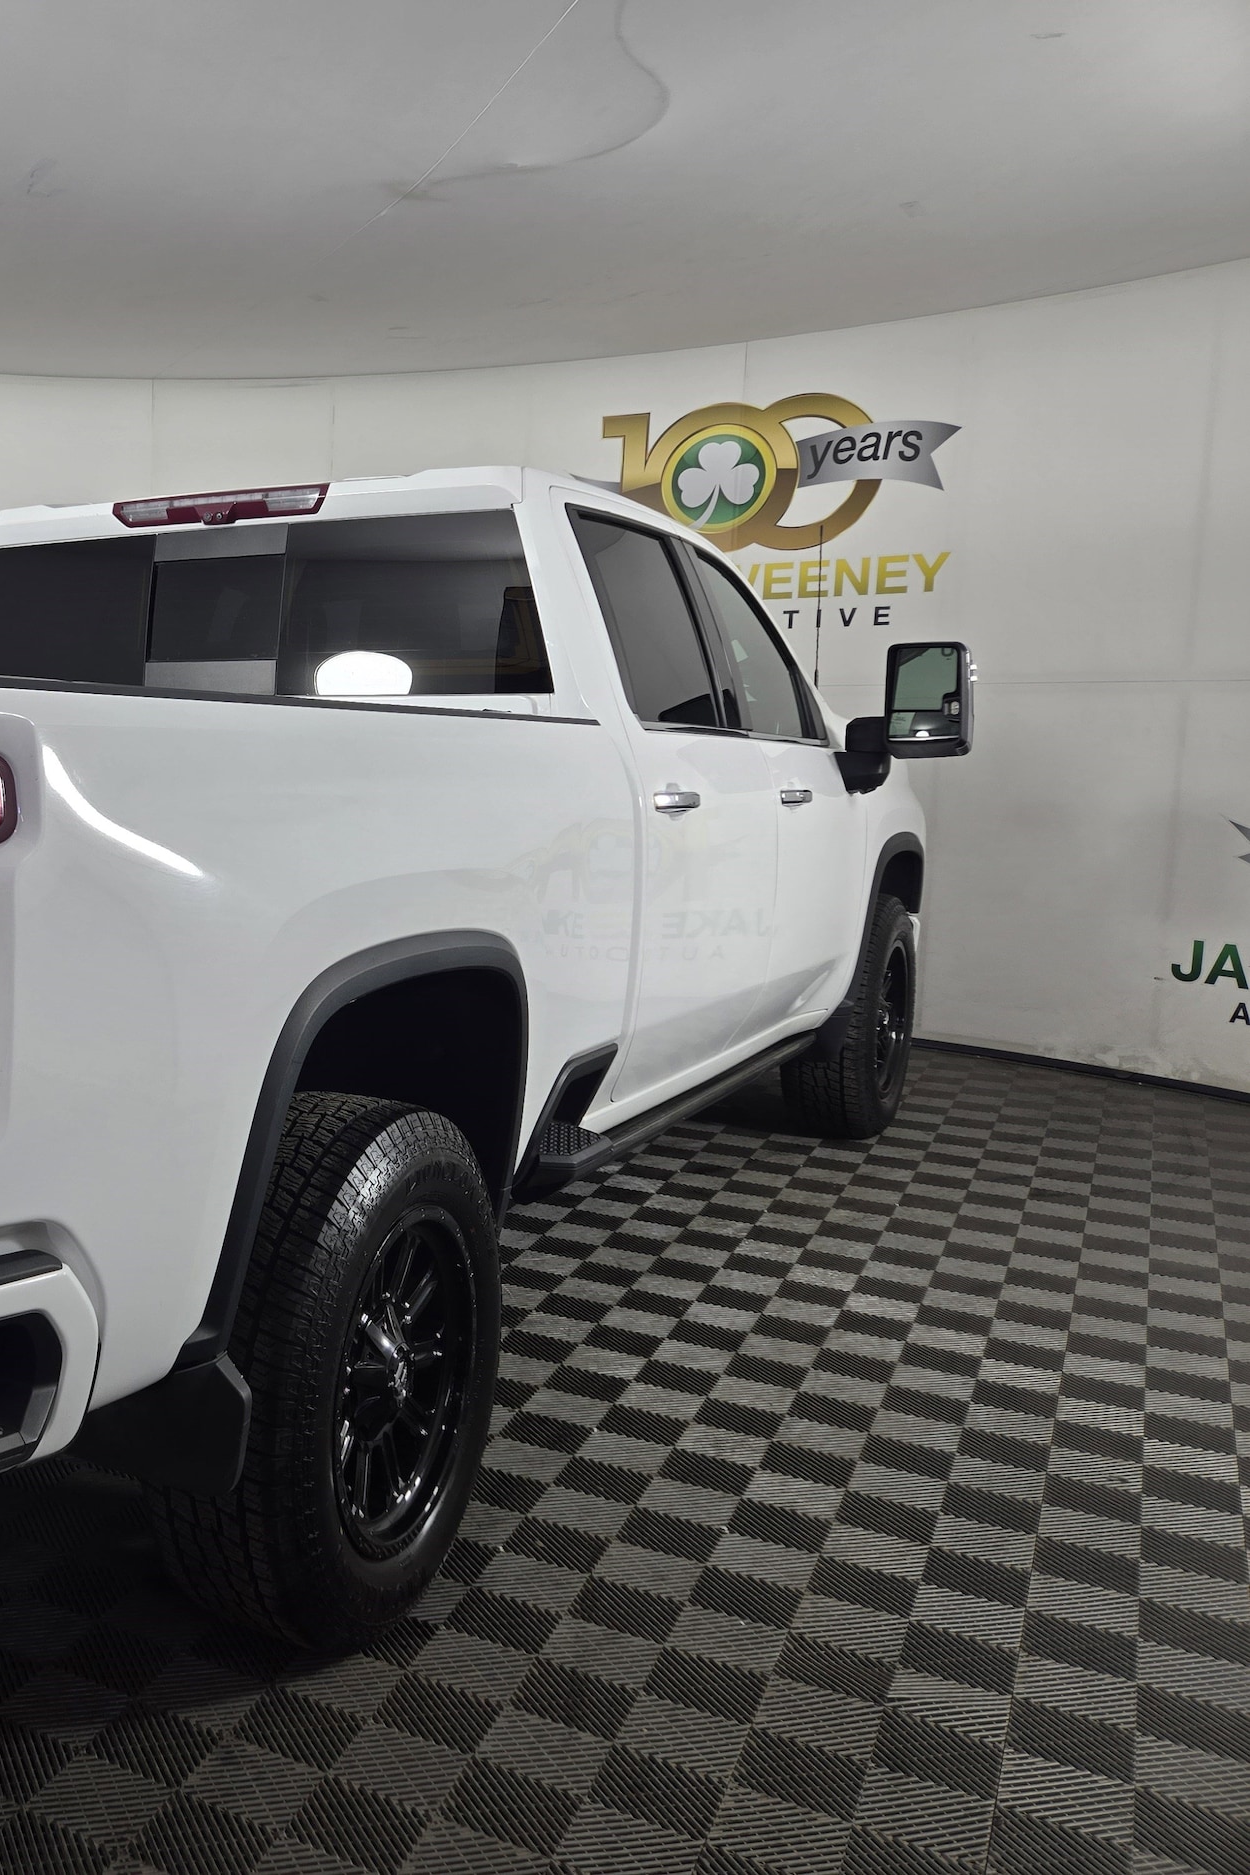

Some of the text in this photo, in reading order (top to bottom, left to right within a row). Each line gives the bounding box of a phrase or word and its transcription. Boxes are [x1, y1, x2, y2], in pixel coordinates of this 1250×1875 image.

[806, 427, 923, 480] years
[736, 551, 951, 600] EENEY
[1171, 940, 1250, 990] JA
